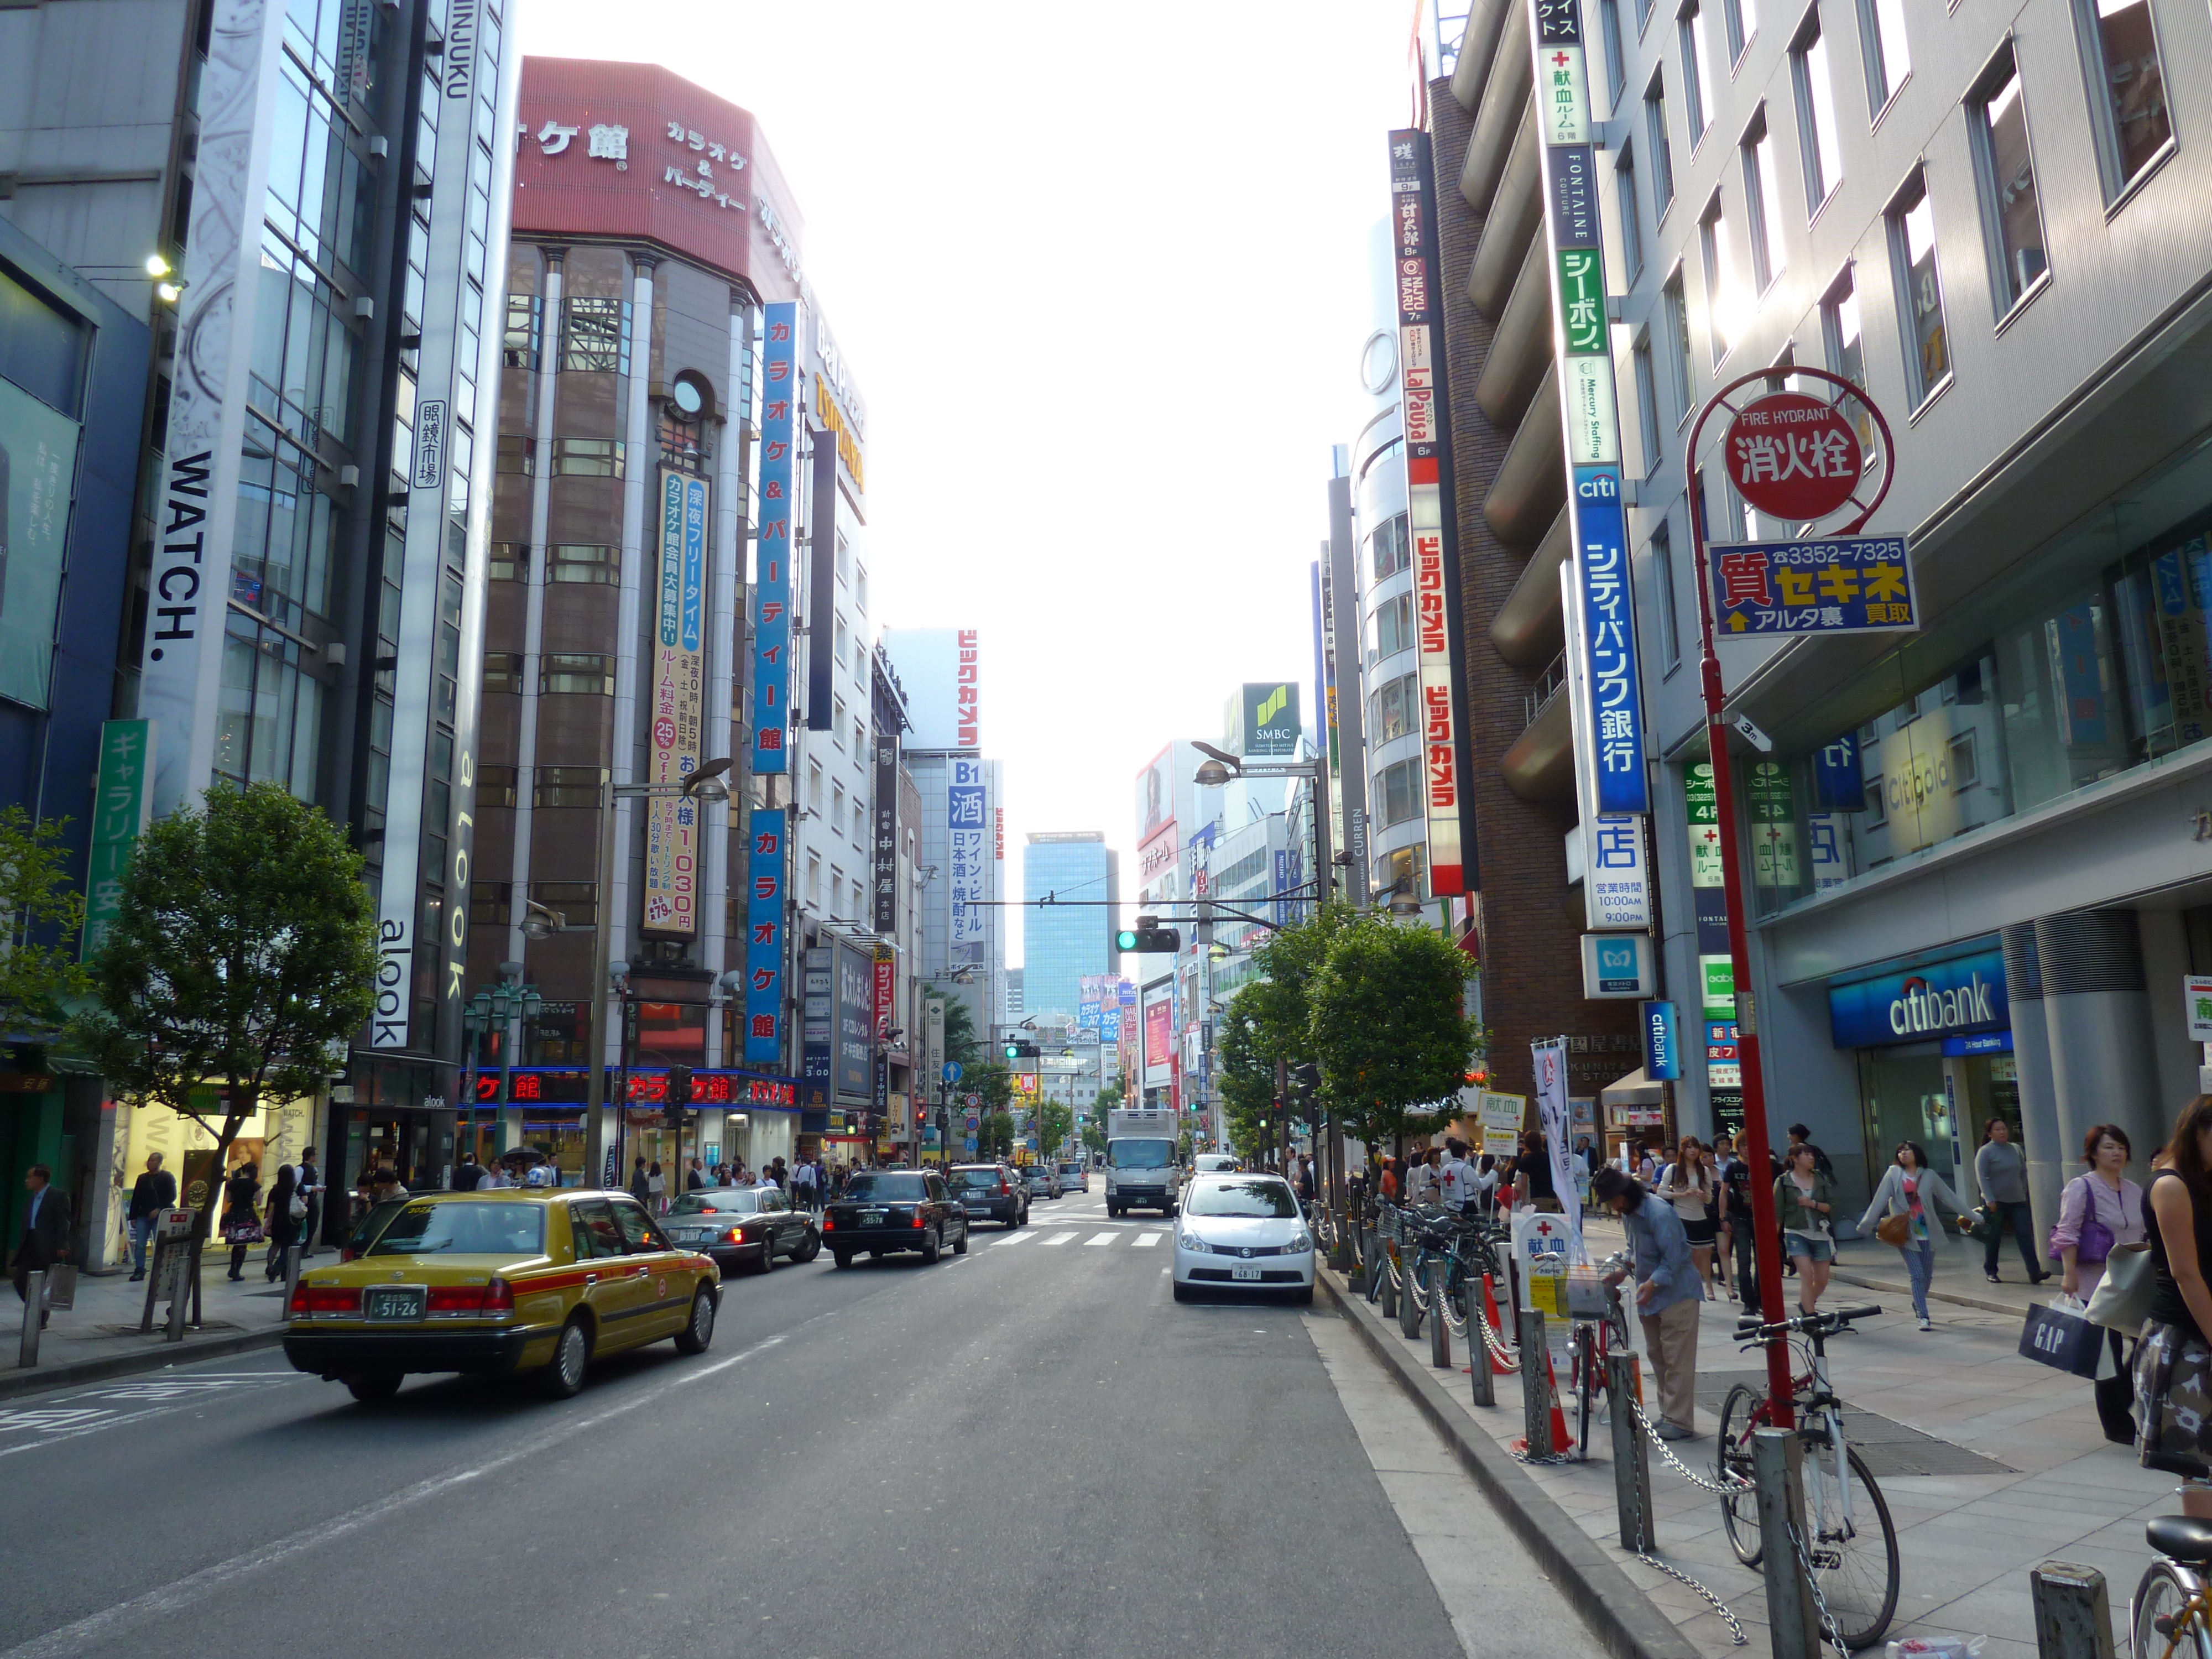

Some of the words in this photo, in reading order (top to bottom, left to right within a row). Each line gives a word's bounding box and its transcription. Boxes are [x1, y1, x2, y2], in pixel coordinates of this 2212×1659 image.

[446, 0, 473, 98] INJUKU
[1553, 70, 1574, 128] 献血ルーム
[667, 122, 747, 170] カラオケ
[697, 160, 713, 178] &
[1401, 183, 1413, 191] 9F
[665, 165, 745, 211] パーティー
[1559, 179, 1569, 216] COUTURE
[1569, 155, 1587, 238] FONTAINE
[1400, 203, 1419, 245] 甘太郎
[1401, 278, 1413, 311] MARU
[1412, 276, 1425, 310] NIJYU
[1408, 312, 1421, 321] 7F
[1407, 368, 1430, 387] La
[1408, 389, 1431, 440] Pausa
[1587, 379, 1597, 418] Mercury
[1741, 411, 1768, 426] FIRE
[1773, 406, 1832, 424] HYDRANT
[421, 404, 441, 484] 眼鏡市場
[1417, 447, 1431, 455] 6F
[1591, 420, 1599, 459] Staffing
[1735, 429, 1854, 484] 消火栓
[1579, 477, 1615, 498] citi
[758, 322, 790, 750] カラオケ&パーティー館
[1789, 542, 1901, 565] 3352-7325
[150, 450, 212, 662] WATCH.
[662, 477, 682, 643] カラオケ館会員大募集中!!
[684, 488, 703, 640] 深夜フリータイム
[1417, 536, 1444, 653] ビックカメラ
[1718, 552, 1773, 609] 質
[1775, 561, 1906, 607] セキネ
[1754, 607, 1844, 630] アルタ裏
[1866, 603, 1911, 624] 買取
[1587, 544, 1634, 772] シティバンク銀行
[658, 650, 677, 716] ルーム料金
[958, 629, 977, 746] ビックカメラ
[656, 722, 674, 747] 25%
[1256, 729, 1290, 739] SMBC
[1426, 685, 1454, 807] ビックカメラ
[1740, 721, 1758, 741] 3m
[956, 763, 979, 784] B1
[952, 792, 983, 823] 酒
[649, 800, 661, 889] 1人30分歌い放題
[1352, 808, 1364, 857] CURREN
[447, 749, 474, 1000] alook
[674, 828, 693, 928] 1,030円
[953, 832, 966, 940] 日本酒・焼酎など
[968, 832, 982, 932] ワイン・ビール
[1595, 882, 1642, 894] 営業時間
[1599, 896, 1641, 906] 10:00AM
[1605, 912, 1643, 922] 9:00PM
[751, 832, 779, 1039] カラオケ館
[877, 945, 892, 961] 薬
[372, 919, 411, 1044] alook
[1081, 1003, 1100, 1016] カラオケ
[1088, 1014, 1100, 1026] 747
[1890, 972, 1996, 1035] citibank
[848, 1020, 868, 1038] CDレンタル
[1652, 1014, 1667, 1067] citibank
[1983, 1038, 2001, 1047] Banking
[424, 1095, 445, 1108] alook
[628, 1076, 729, 1099] カラケ館
[1486, 1097, 1518, 1114] 献血
[283, 1108, 305, 1118] WATCH.
[1527, 1237, 1566, 1254] 献血
[382, 1302, 418, 1316] 51-26
[2034, 1323, 2064, 1353] GAP
